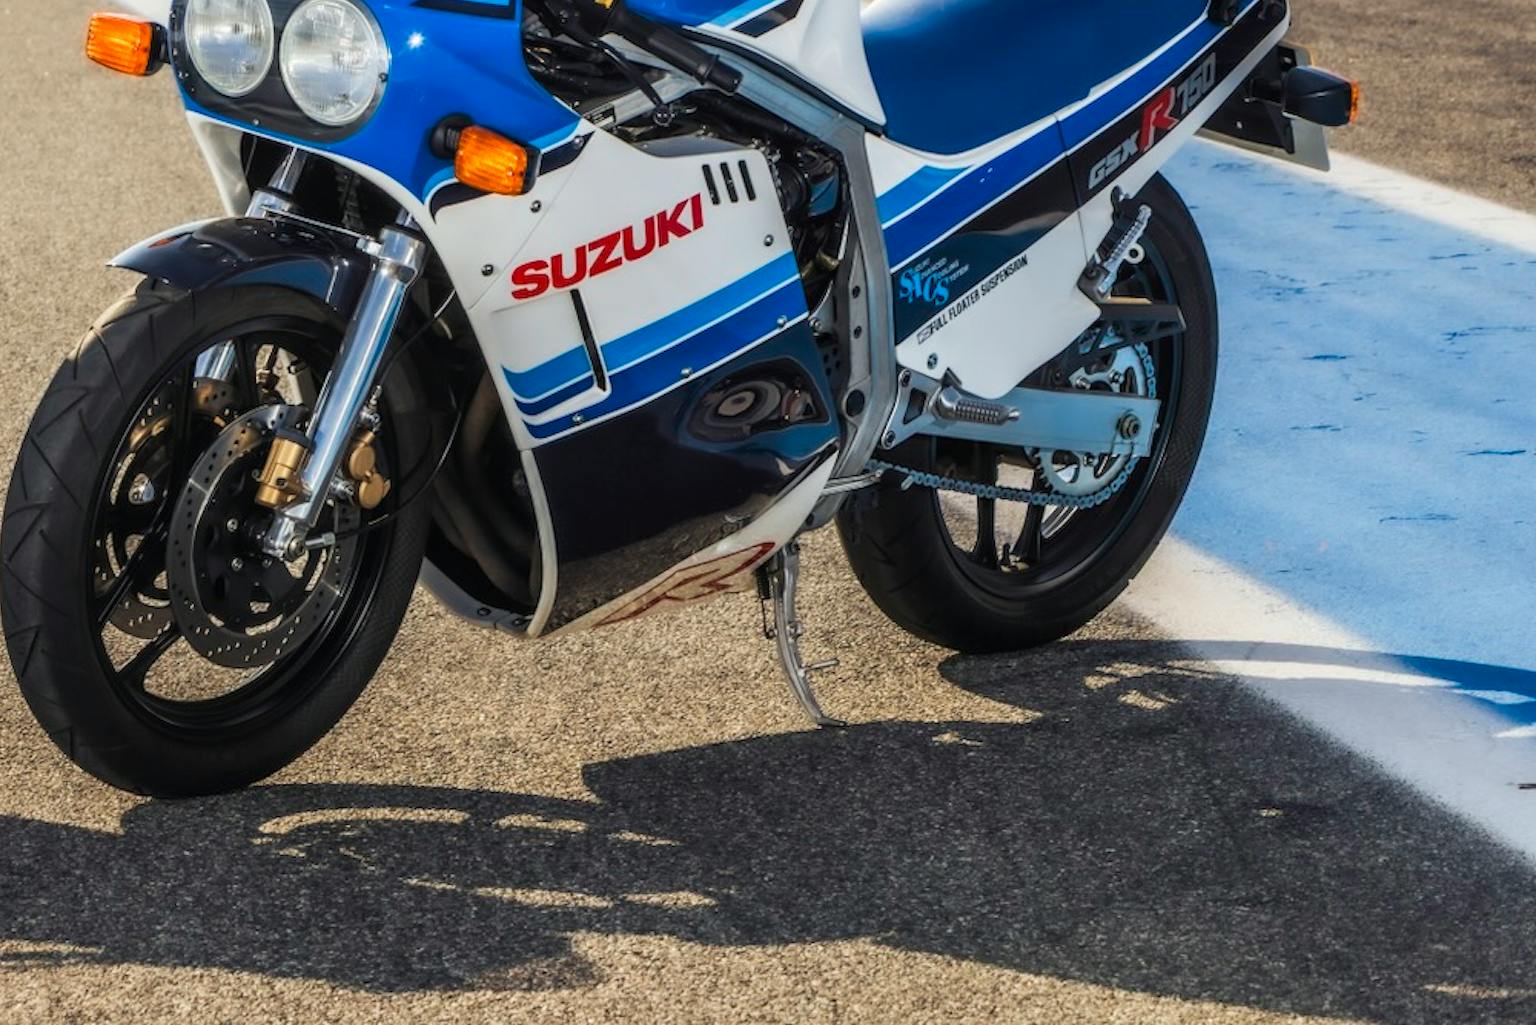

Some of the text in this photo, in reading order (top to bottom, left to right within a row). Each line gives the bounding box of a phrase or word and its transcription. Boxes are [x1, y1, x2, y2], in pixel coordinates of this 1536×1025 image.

[511, 192, 705, 301] SUZUKI
[947, 288, 981, 321] FLOATER
[981, 253, 1029, 297] SUSPENSION
